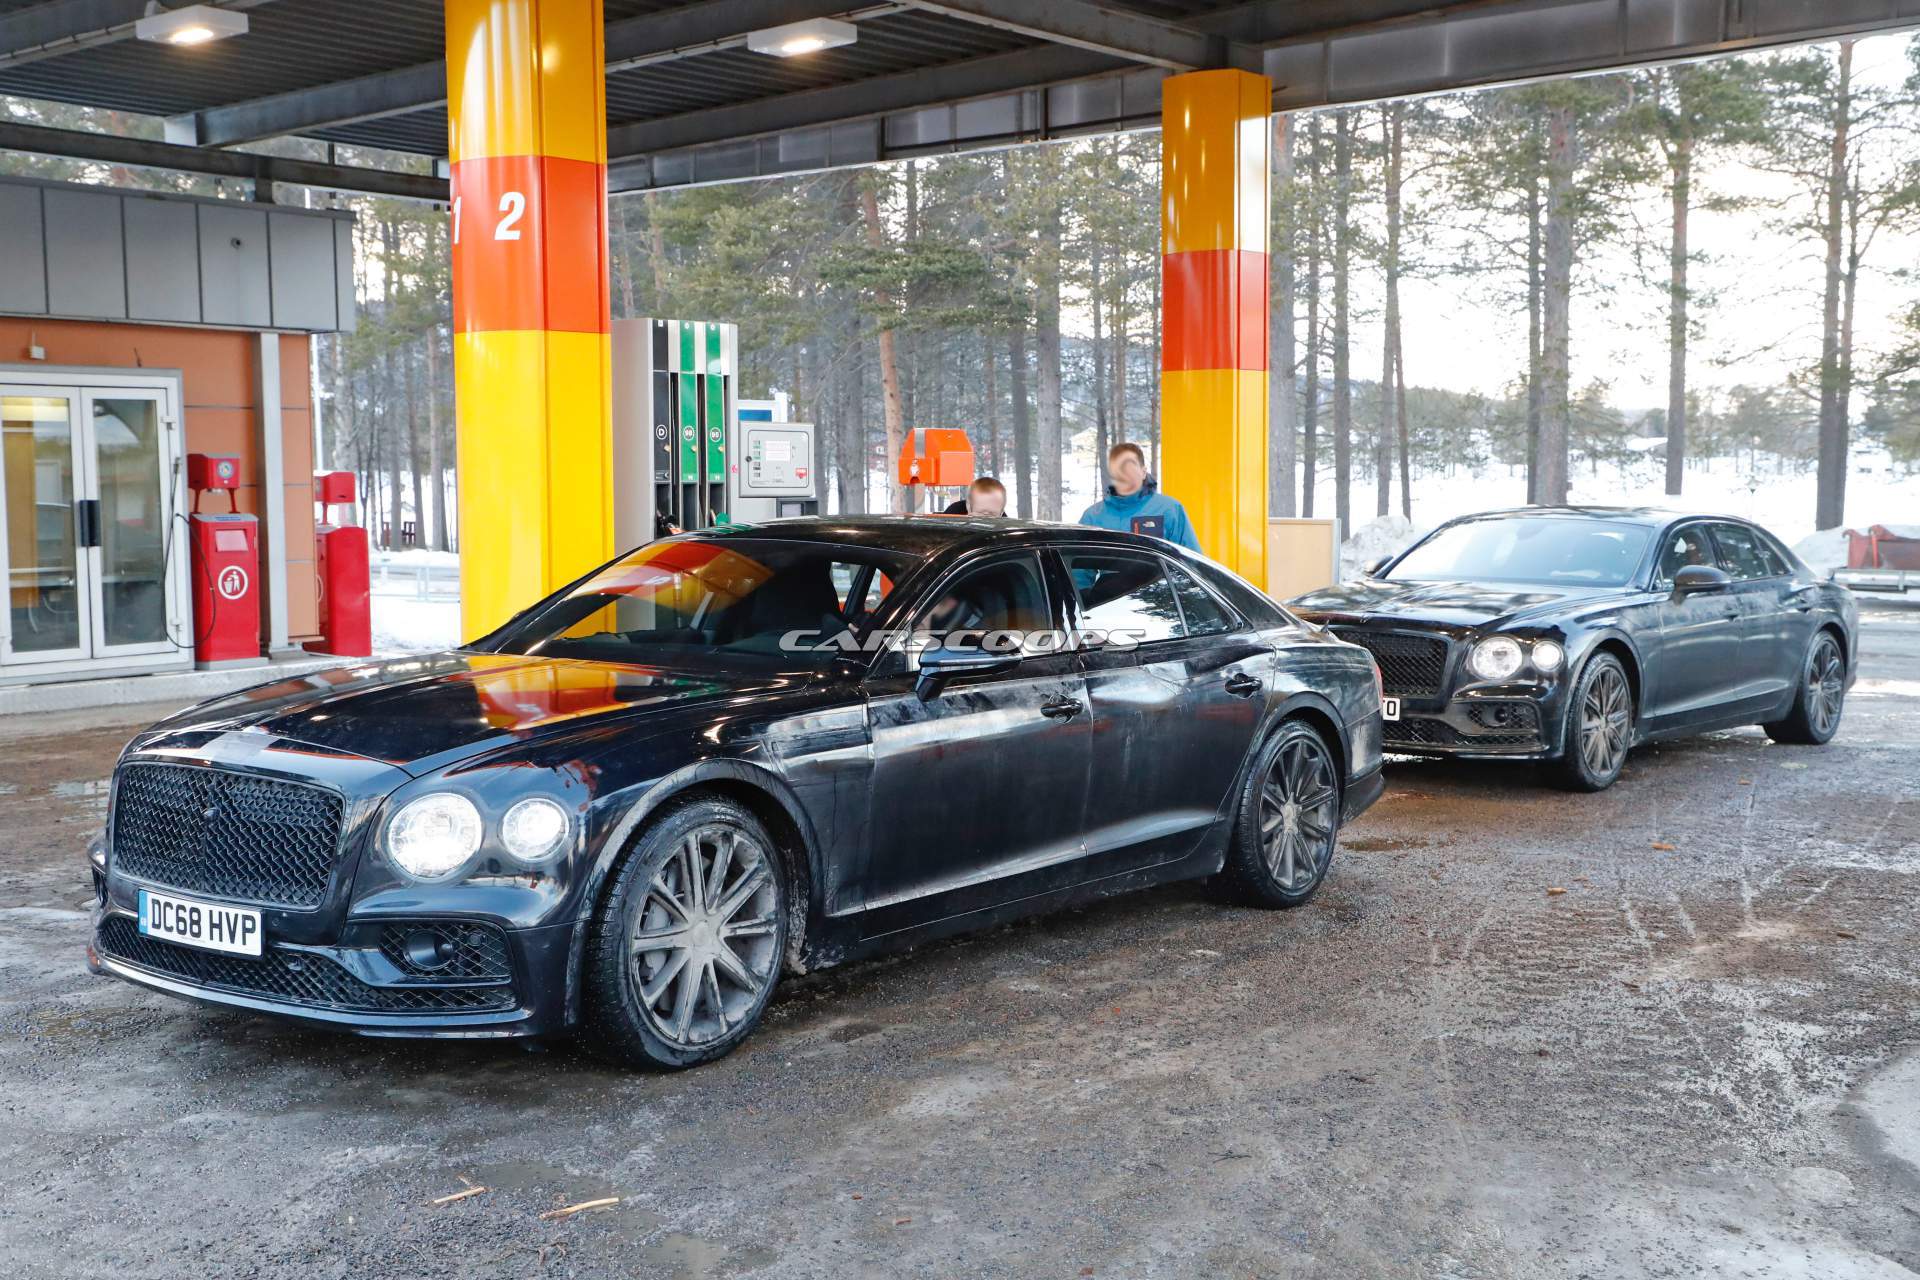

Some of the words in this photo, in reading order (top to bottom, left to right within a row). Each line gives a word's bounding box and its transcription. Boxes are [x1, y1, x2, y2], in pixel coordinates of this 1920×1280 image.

[453, 196, 462, 245] 1
[494, 191, 526, 241] 2
[658, 428, 665, 436] D
[151, 898, 202, 938] DC68
[209, 909, 257, 946] HVP
